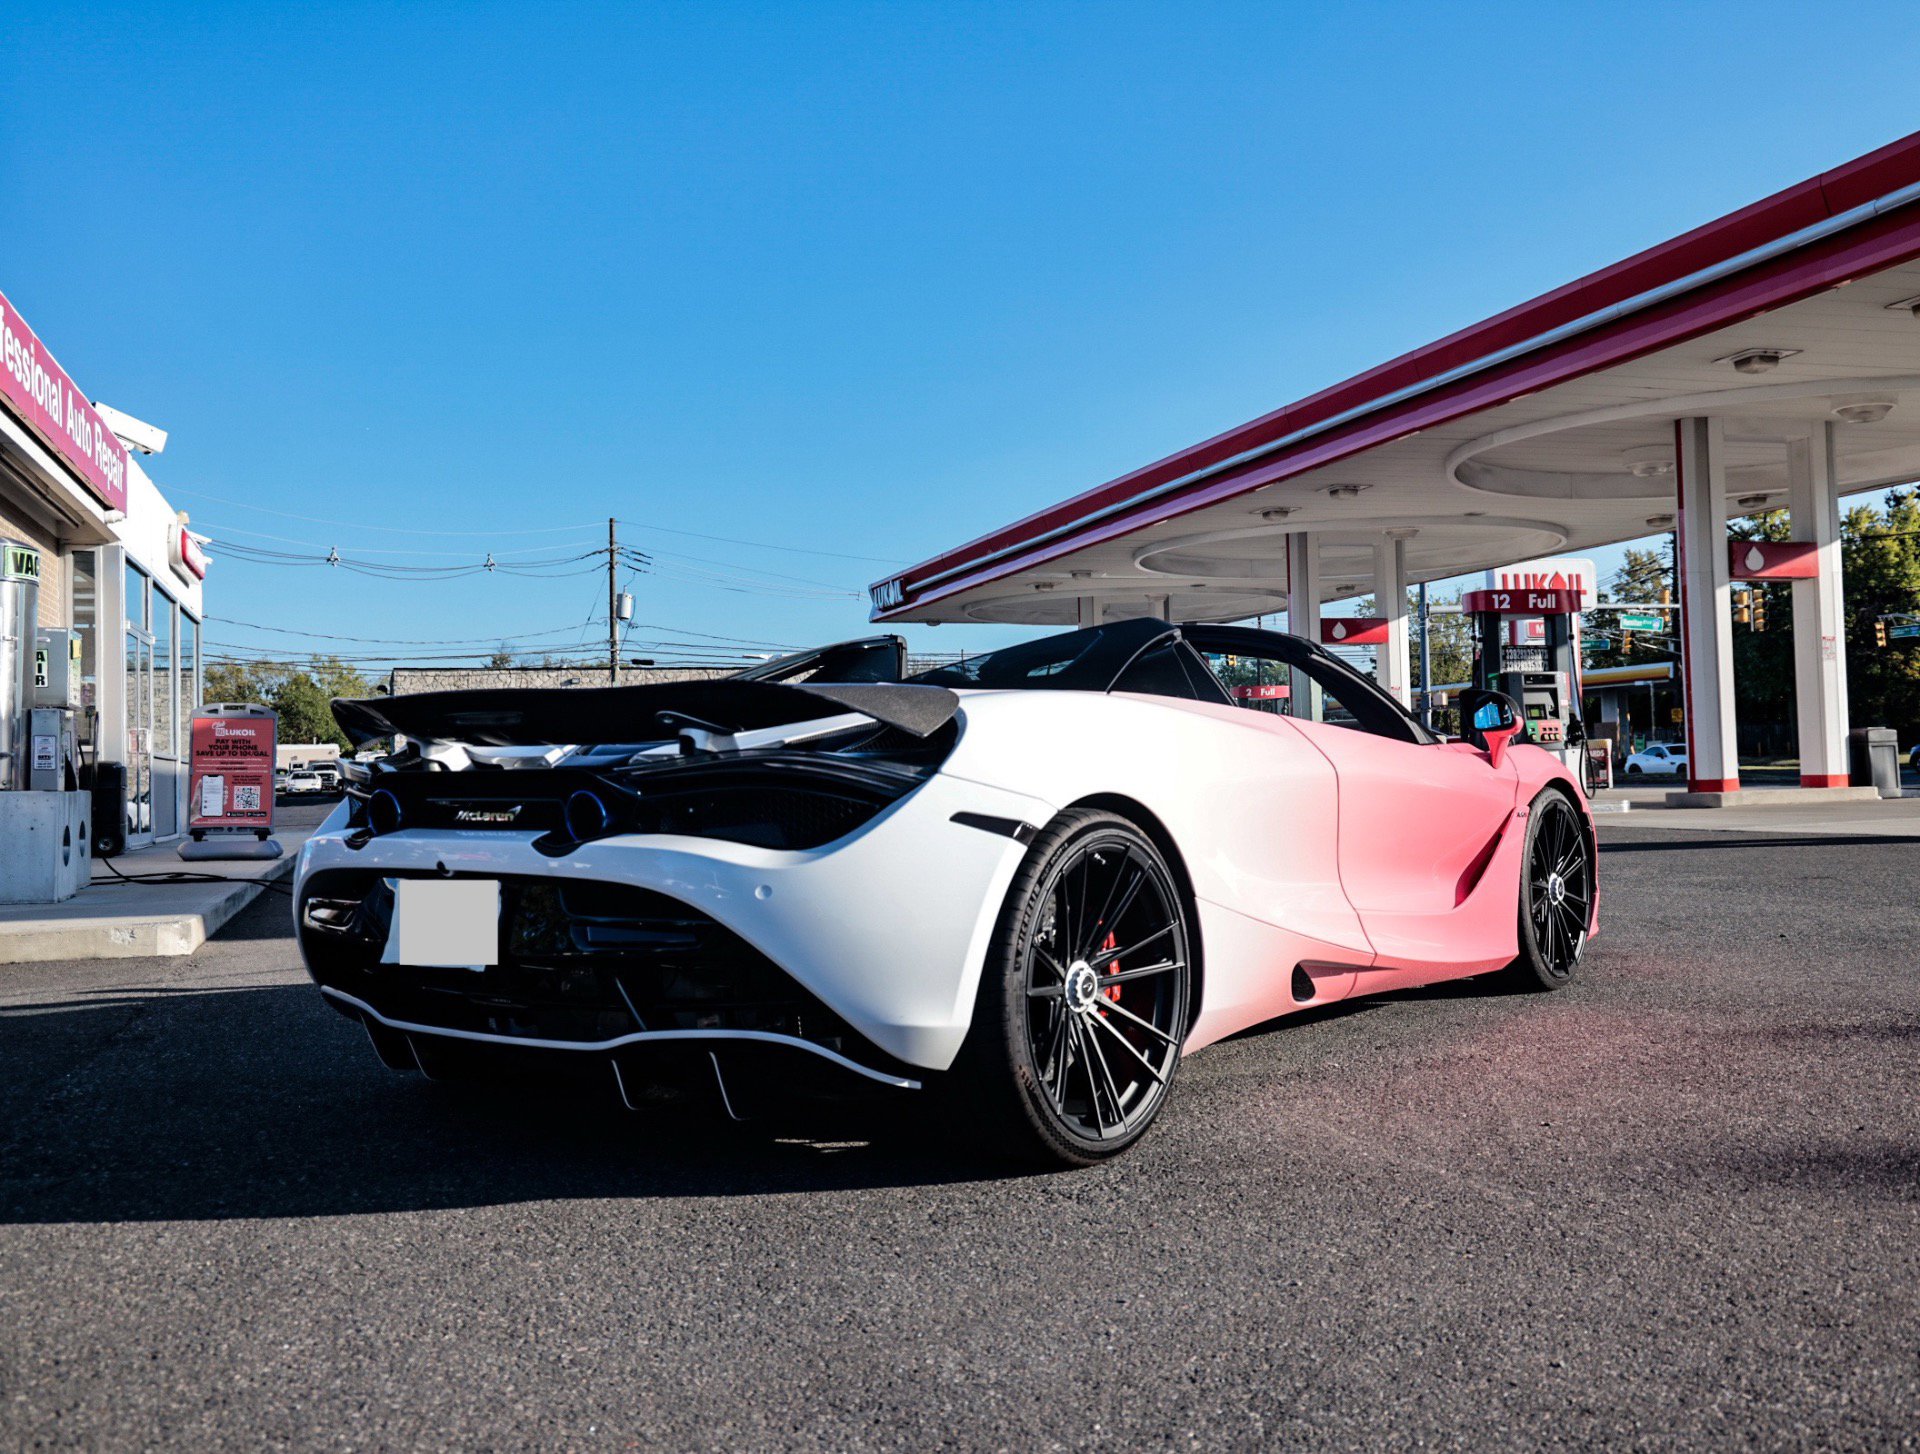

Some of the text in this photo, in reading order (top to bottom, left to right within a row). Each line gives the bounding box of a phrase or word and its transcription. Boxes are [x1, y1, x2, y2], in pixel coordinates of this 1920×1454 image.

[66, 389, 92, 458] Auto
[94, 421, 123, 492] Repair
[1492, 594, 1556, 609] 12 Full
[35, 651, 46, 686] AIR
[1245, 688, 1276, 697] 2 Full
[456, 809, 516, 821] McLaren
